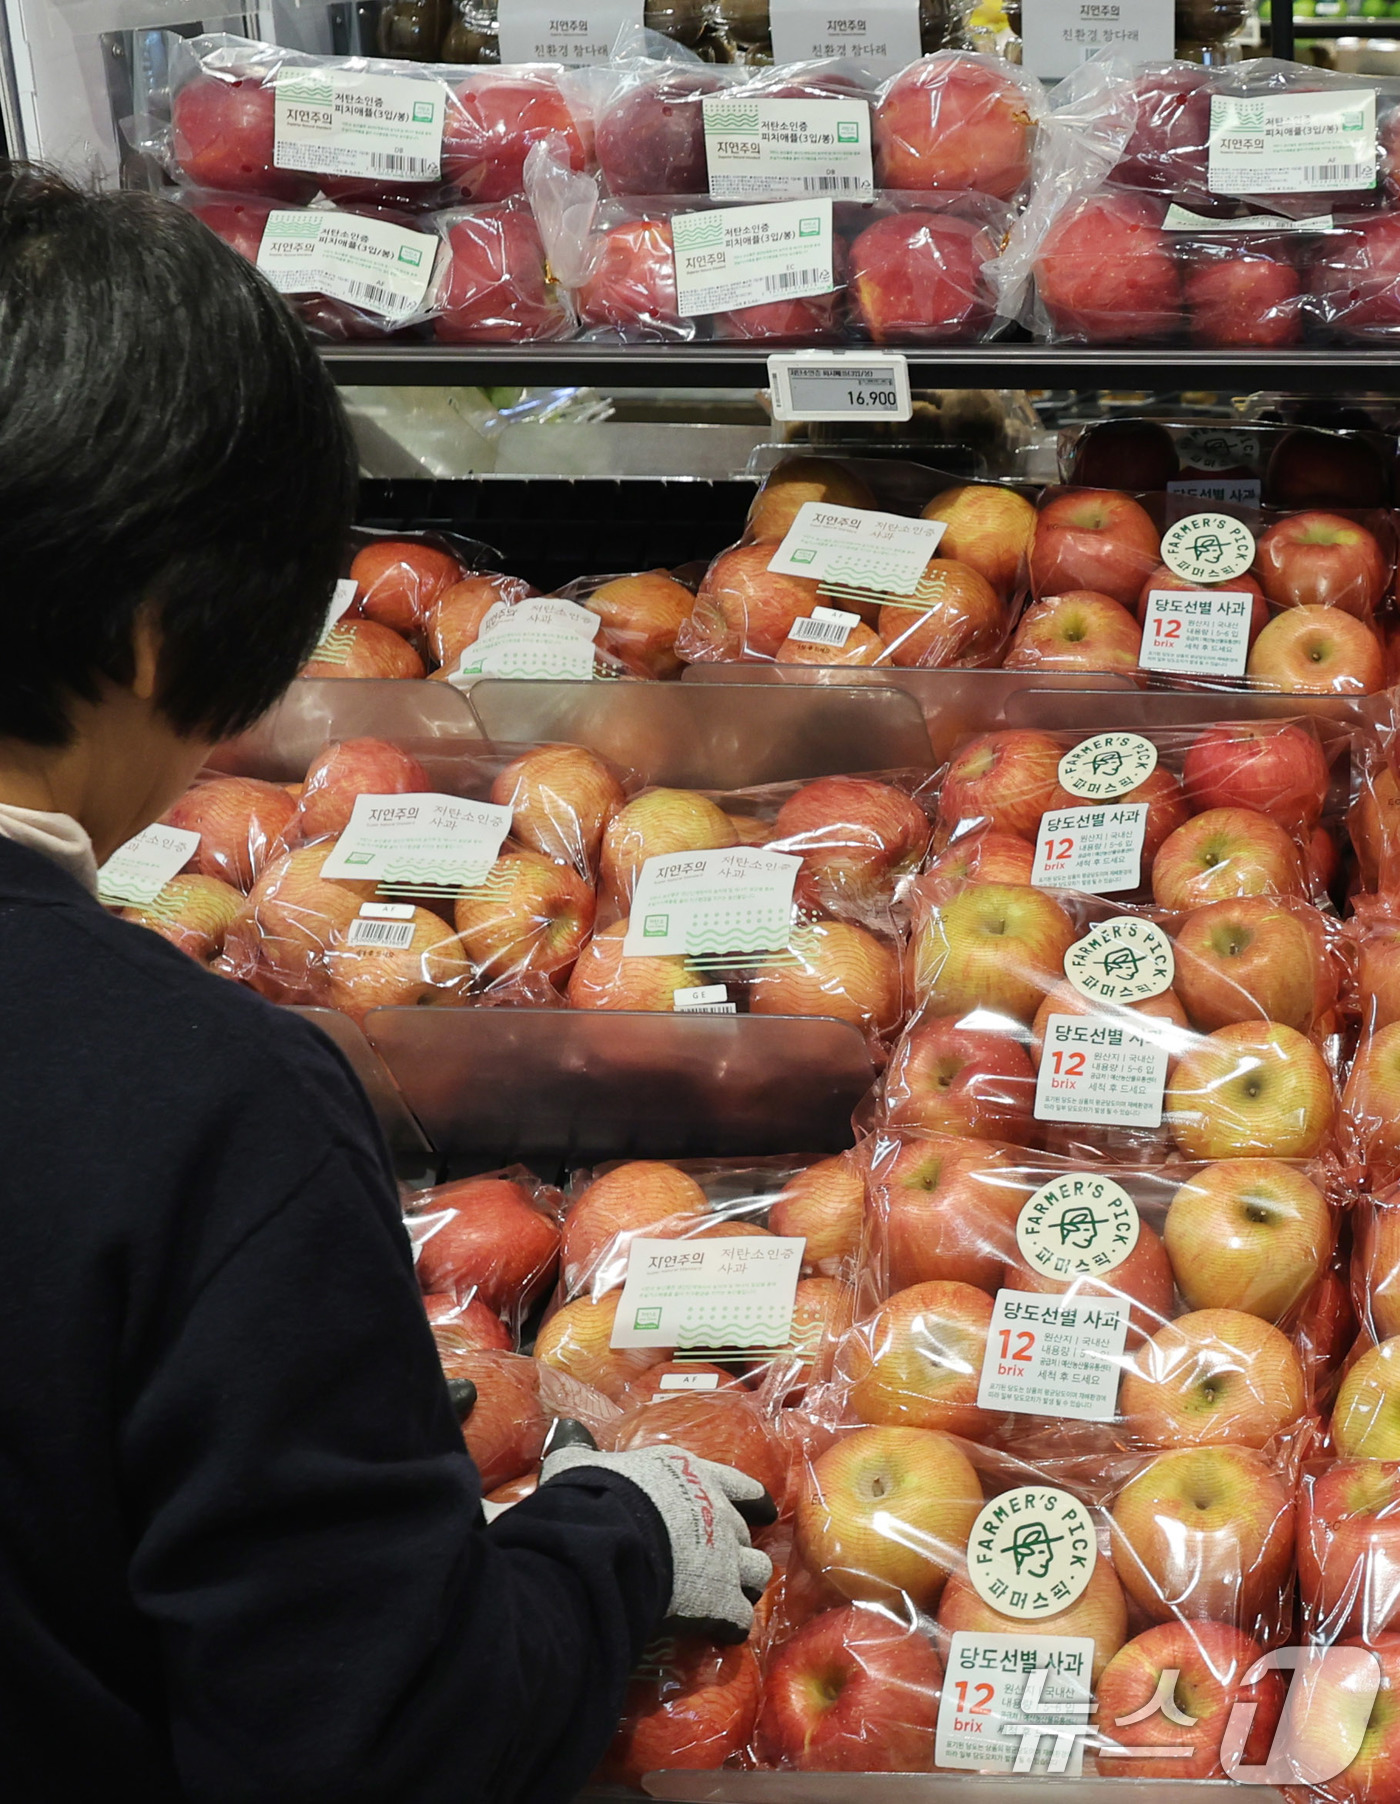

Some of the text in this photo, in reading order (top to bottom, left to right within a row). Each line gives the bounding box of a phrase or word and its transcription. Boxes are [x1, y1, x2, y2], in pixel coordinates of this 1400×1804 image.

[1062, 29, 1099, 42] 친환경
[534, 44, 569, 57] 친환경
[812, 43, 847, 57] 친환경
[334, 93, 383, 107] 저탄소인증
[761, 121, 808, 132] 저탄소인증
[725, 223, 769, 237] 저탄소인증
[1168, 518, 1249, 561] FARMER'S PICK
[1177, 561, 1235, 577] 파머스픽
[1155, 599, 1245, 616] 당도선별 사과
[1153, 618, 1182, 638] 12
[1154, 640, 1174, 648] brix
[1065, 737, 1151, 774] FARMER'S PICK
[1073, 776, 1134, 793] 파머스픽
[1048, 809, 1140, 832] 당도선별 사과
[1044, 838, 1074, 861] 12
[1044, 861, 1065, 871] brix
[1072, 923, 1167, 978] FARMER'S PICK
[1082, 975, 1152, 998] 파머스픽
[1055, 1025, 1123, 1046] 당도선별
[1052, 1051, 1086, 1076] 12
[1051, 1077, 1076, 1089] brix
[1025, 1181, 1131, 1245] FARMER'S PICK
[1004, 1302, 1121, 1331] 당도선별 사과
[998, 1329, 1036, 1362] 12
[1044, 1332, 1110, 1348] 원산지 국내산
[997, 1363, 1025, 1377] brix
[1037, 1369, 1101, 1385] 세척 후 드세요
[976, 1493, 1088, 1569] FARMER'S PICK
[988, 1578, 1071, 1610] 파머스픽
[960, 1647, 1084, 1676] 당도선별 사과
[954, 1680, 995, 1716] 12
[953, 1717, 983, 1734] brix
